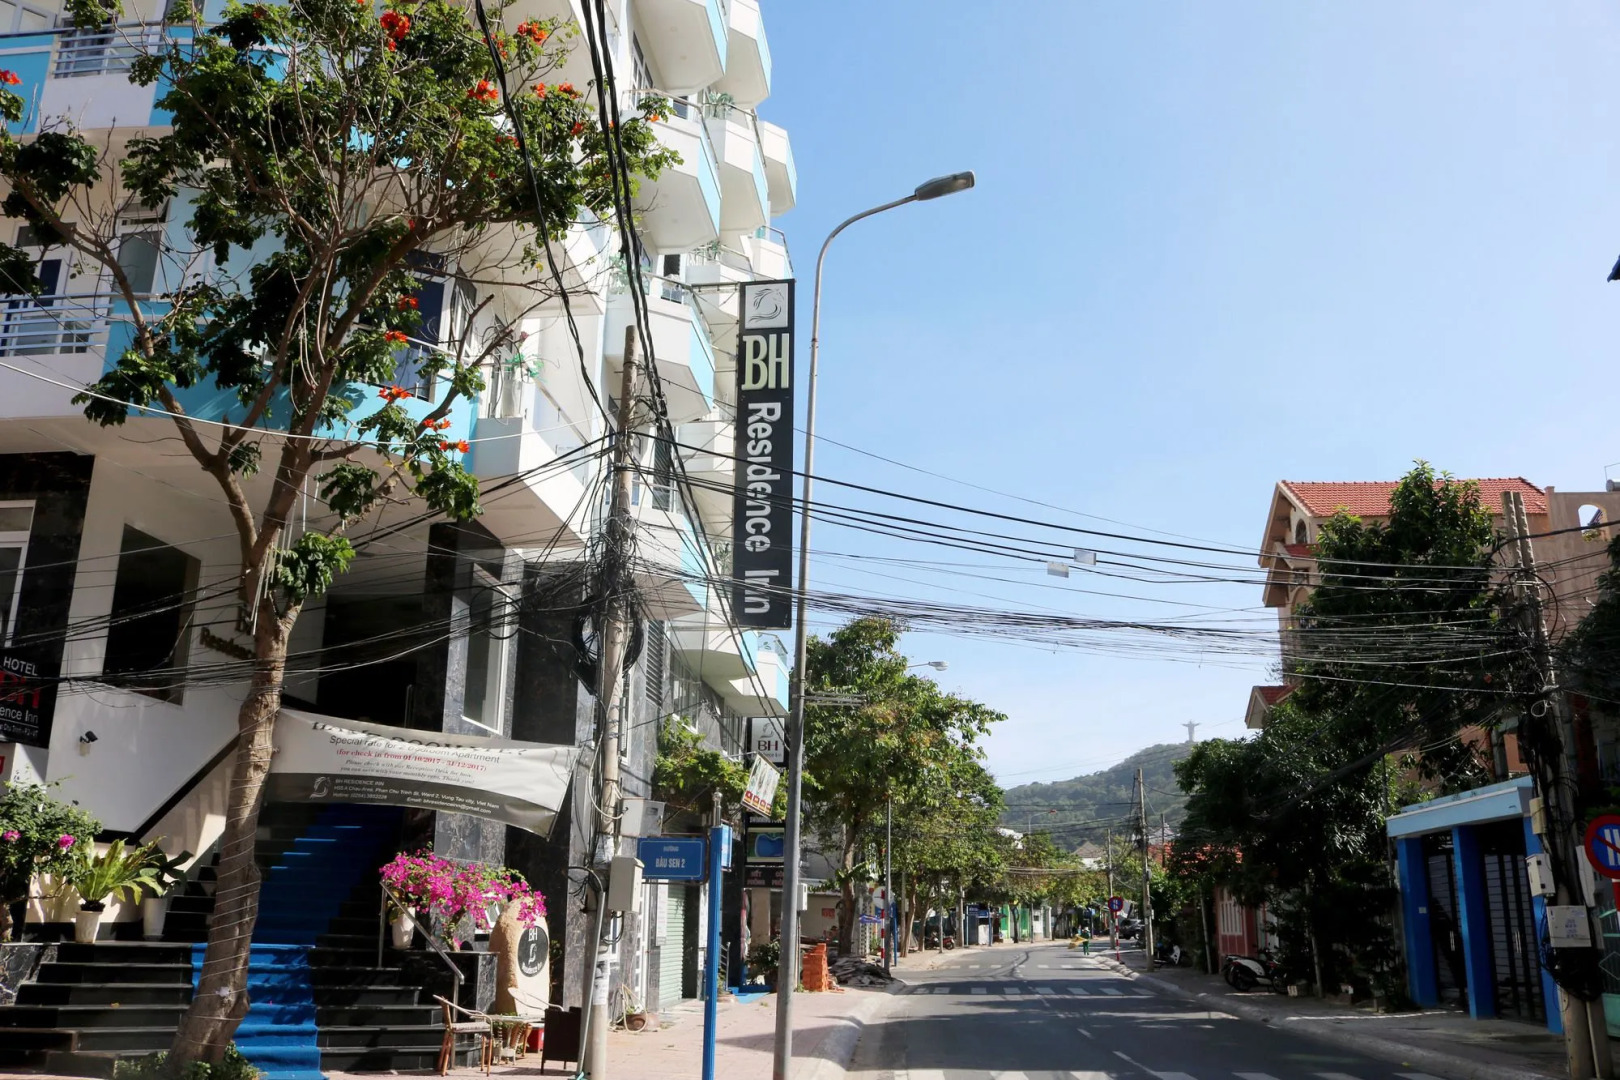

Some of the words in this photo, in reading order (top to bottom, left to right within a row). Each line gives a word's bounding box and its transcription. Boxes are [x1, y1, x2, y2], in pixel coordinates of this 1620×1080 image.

[741, 333, 789, 390] BH
[744, 402, 781, 552] Residence
[744, 569, 779, 614] Inn
[3, 656, 38, 676] HOTEL
[25, 709, 38, 724] Inn
[329, 735, 363, 746] Special
[451, 750, 500, 763] Apartment
[336, 748, 350, 756] (for
[384, 752, 402, 760] from
[758, 740, 778, 751] BH
[668, 858, 681, 868] SEN
